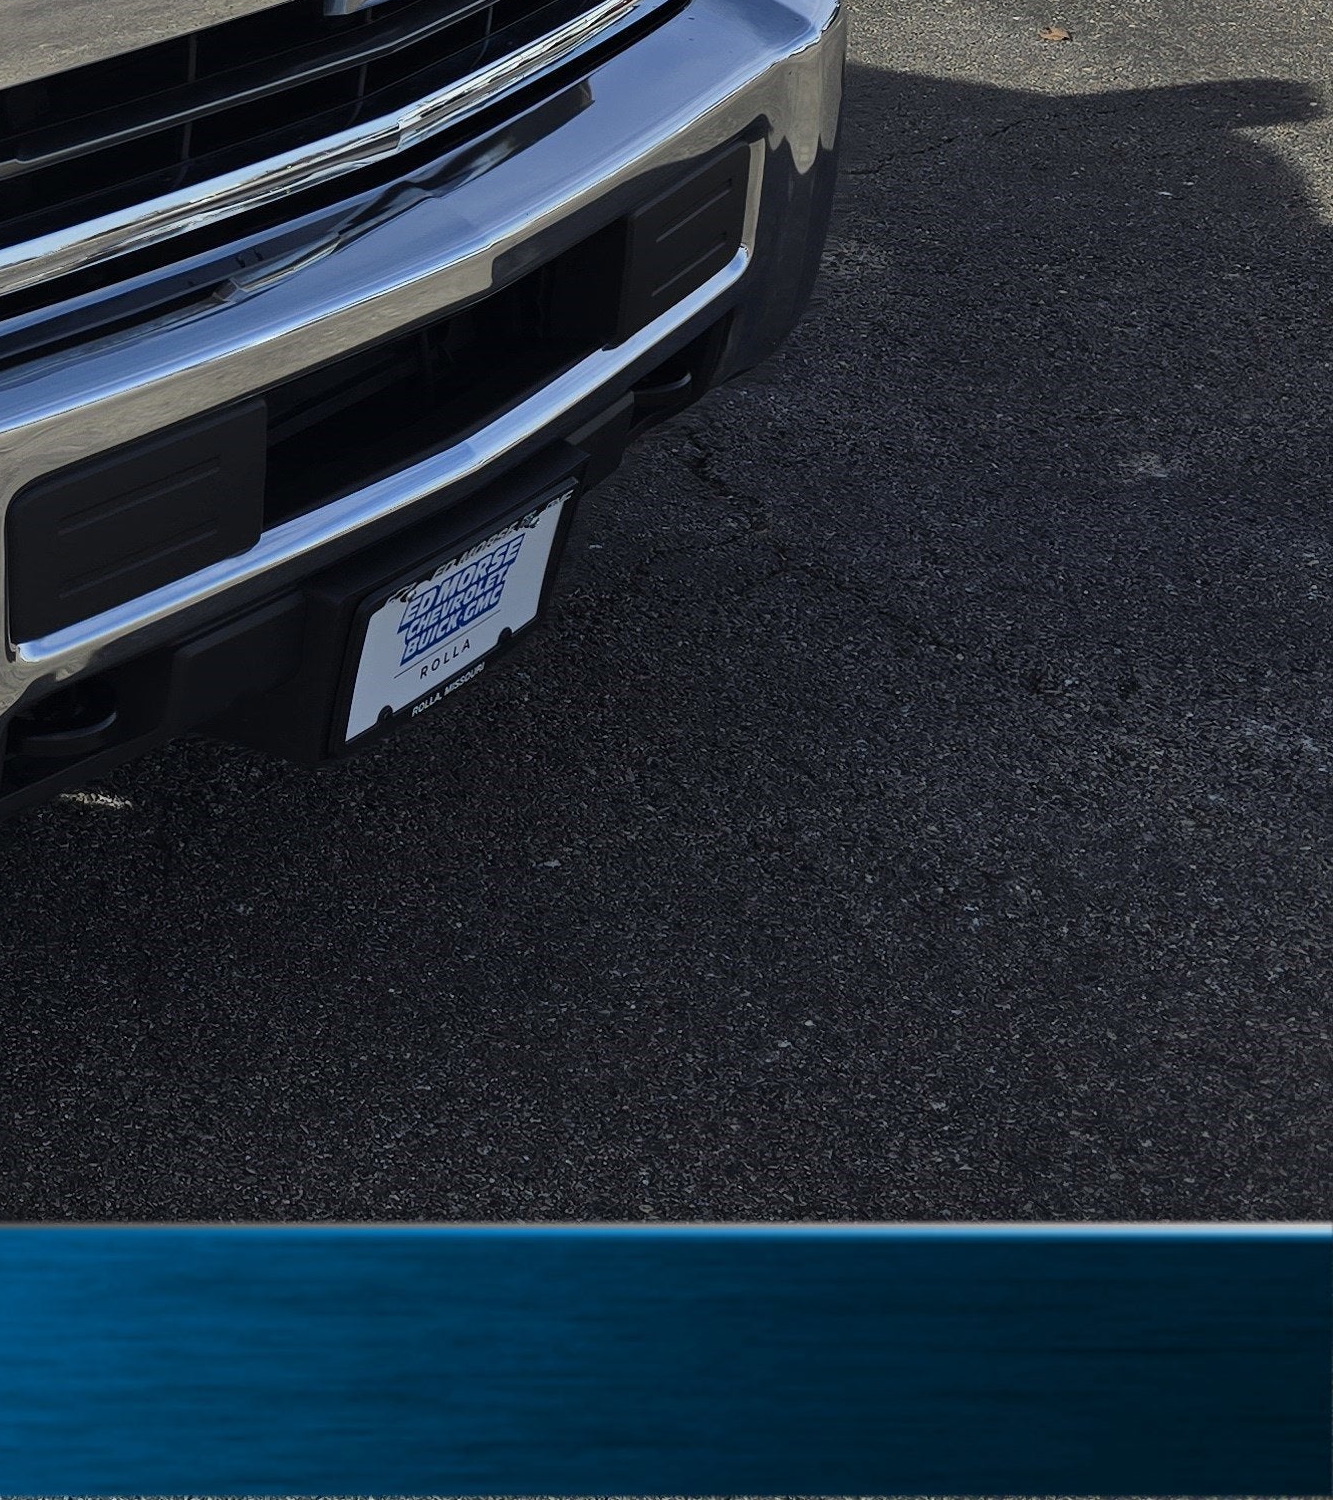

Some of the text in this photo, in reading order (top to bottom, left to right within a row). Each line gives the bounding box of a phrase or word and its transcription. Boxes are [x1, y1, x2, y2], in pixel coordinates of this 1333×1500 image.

[400, 534, 525, 629] ED MORSE
[405, 564, 510, 641] CHEVROLET
[419, 638, 470, 680] ROLLA
[443, 660, 486, 697] MISSOURI
